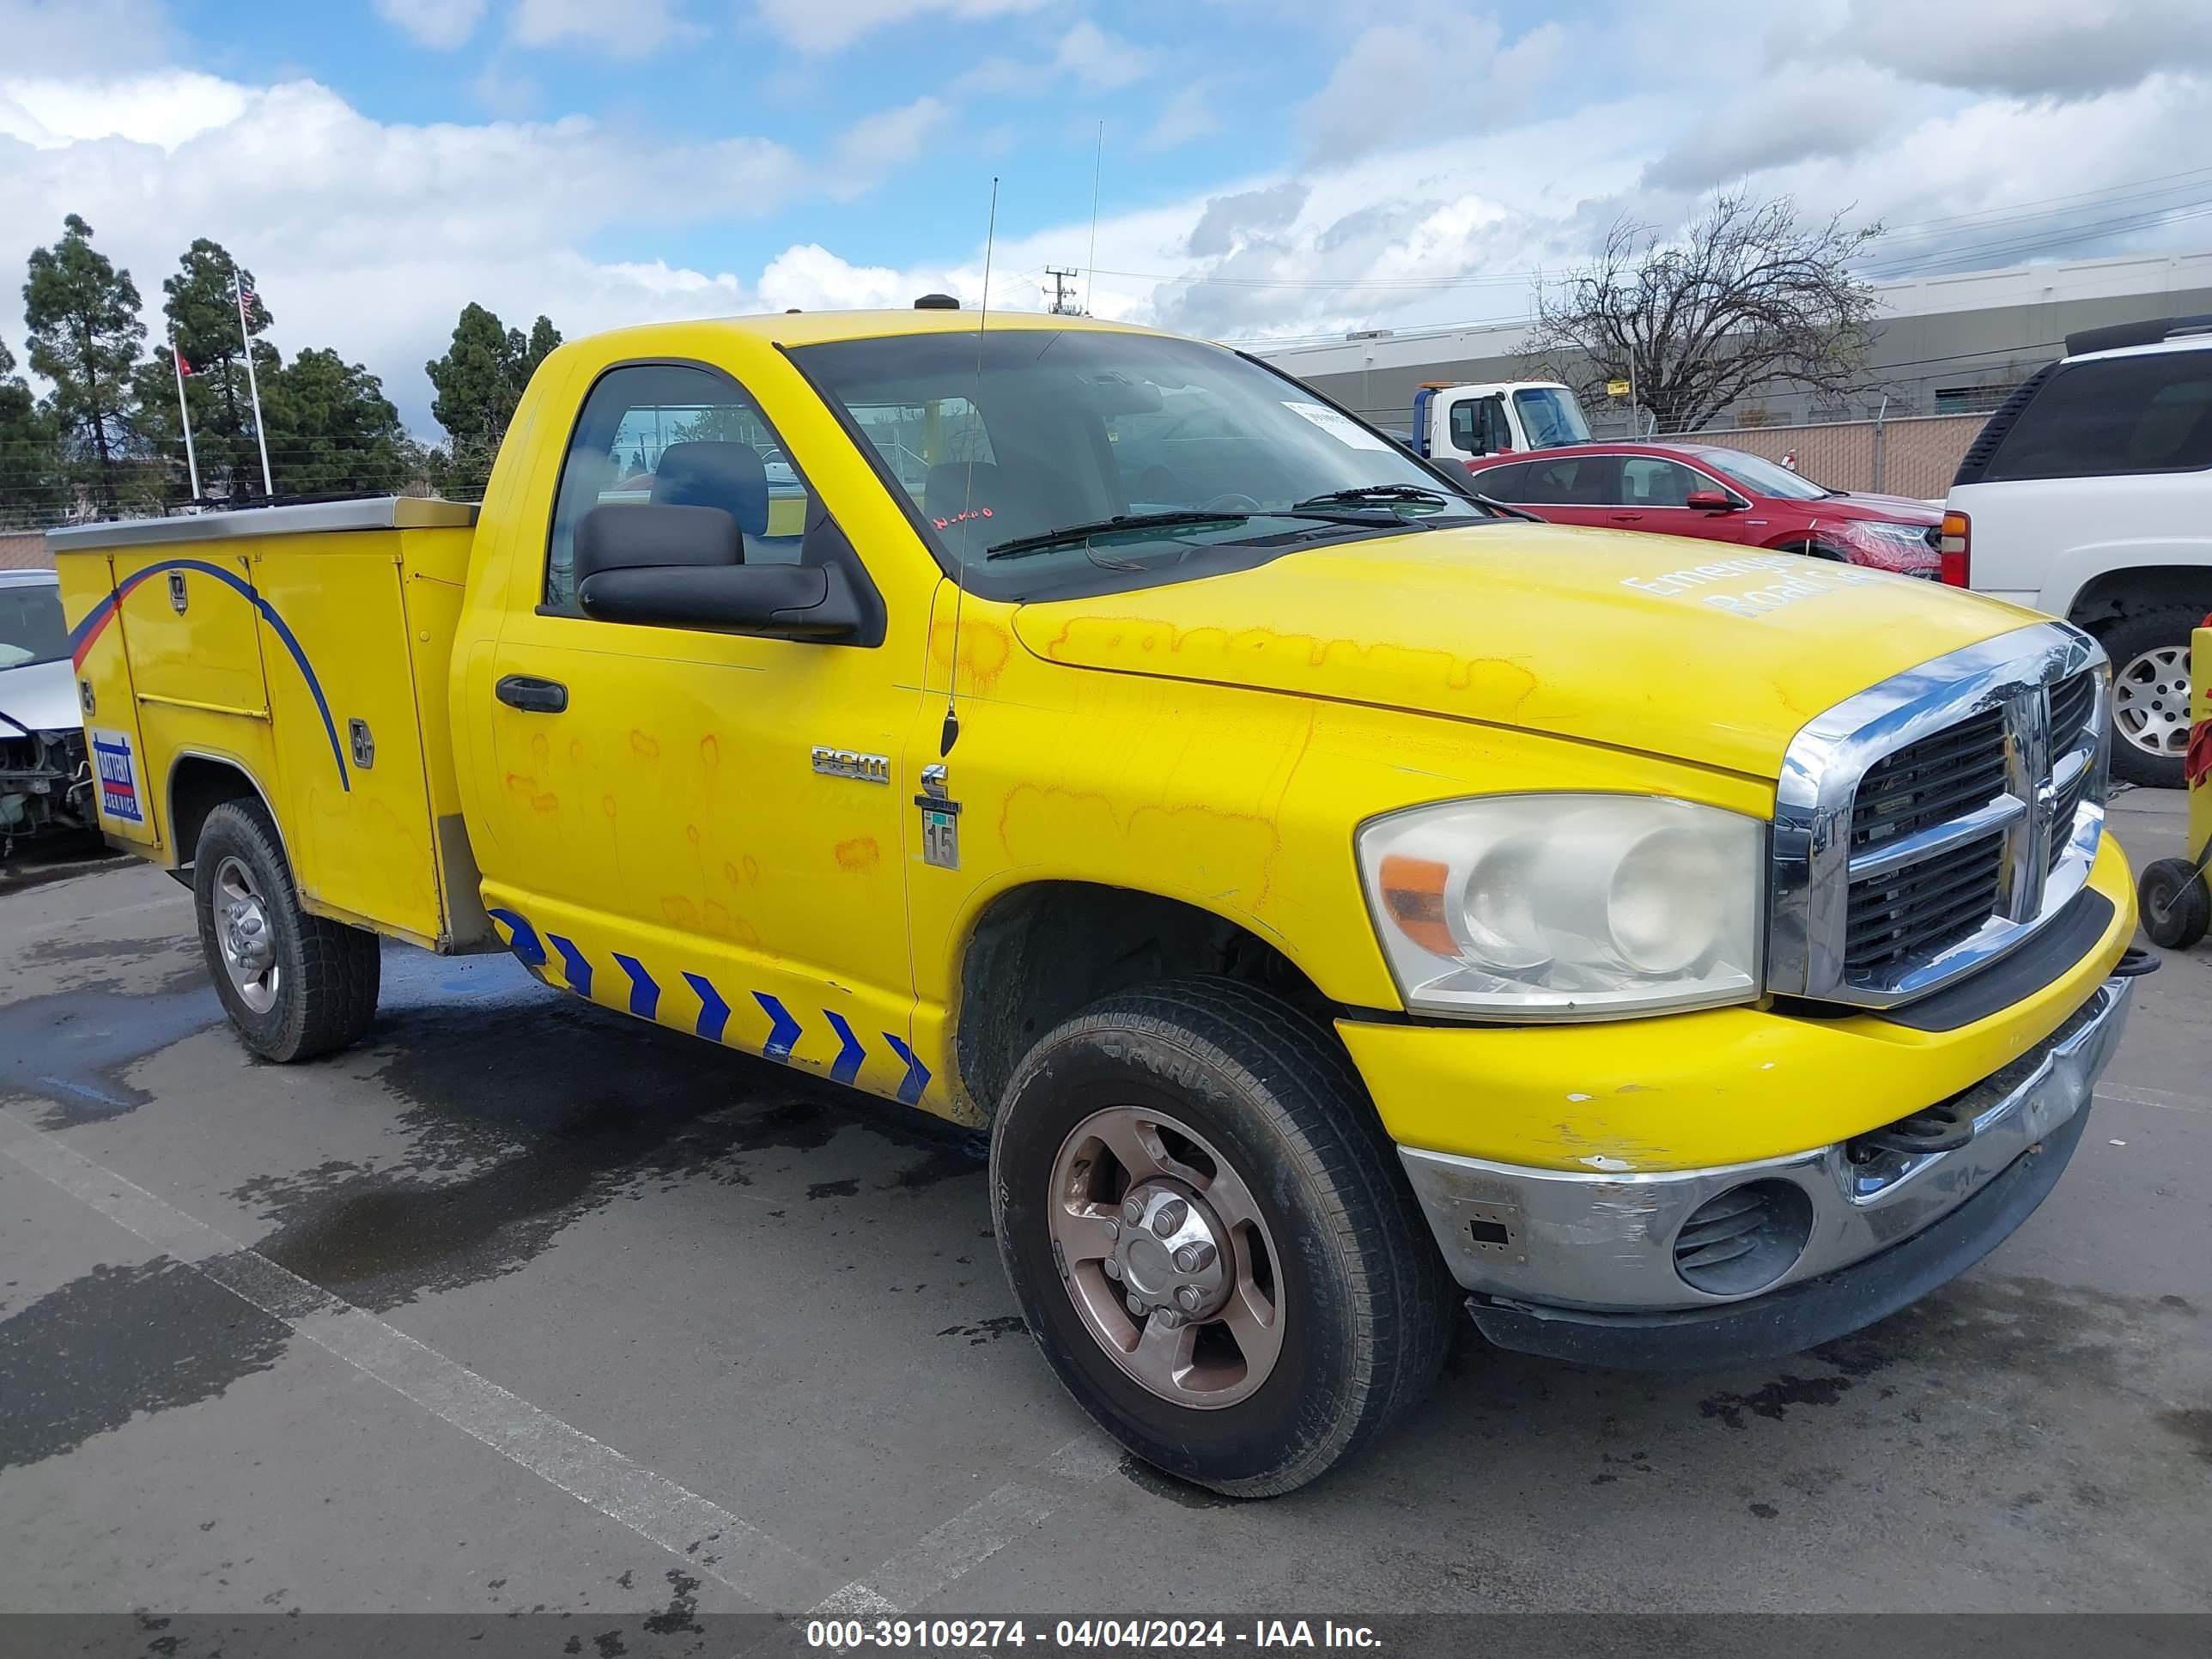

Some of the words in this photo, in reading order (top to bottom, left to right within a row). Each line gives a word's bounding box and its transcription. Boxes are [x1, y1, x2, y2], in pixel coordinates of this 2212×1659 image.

[98, 750, 130, 783] BATTERY
[105, 792, 136, 813] SERVICE
[927, 823, 954, 860] 15
